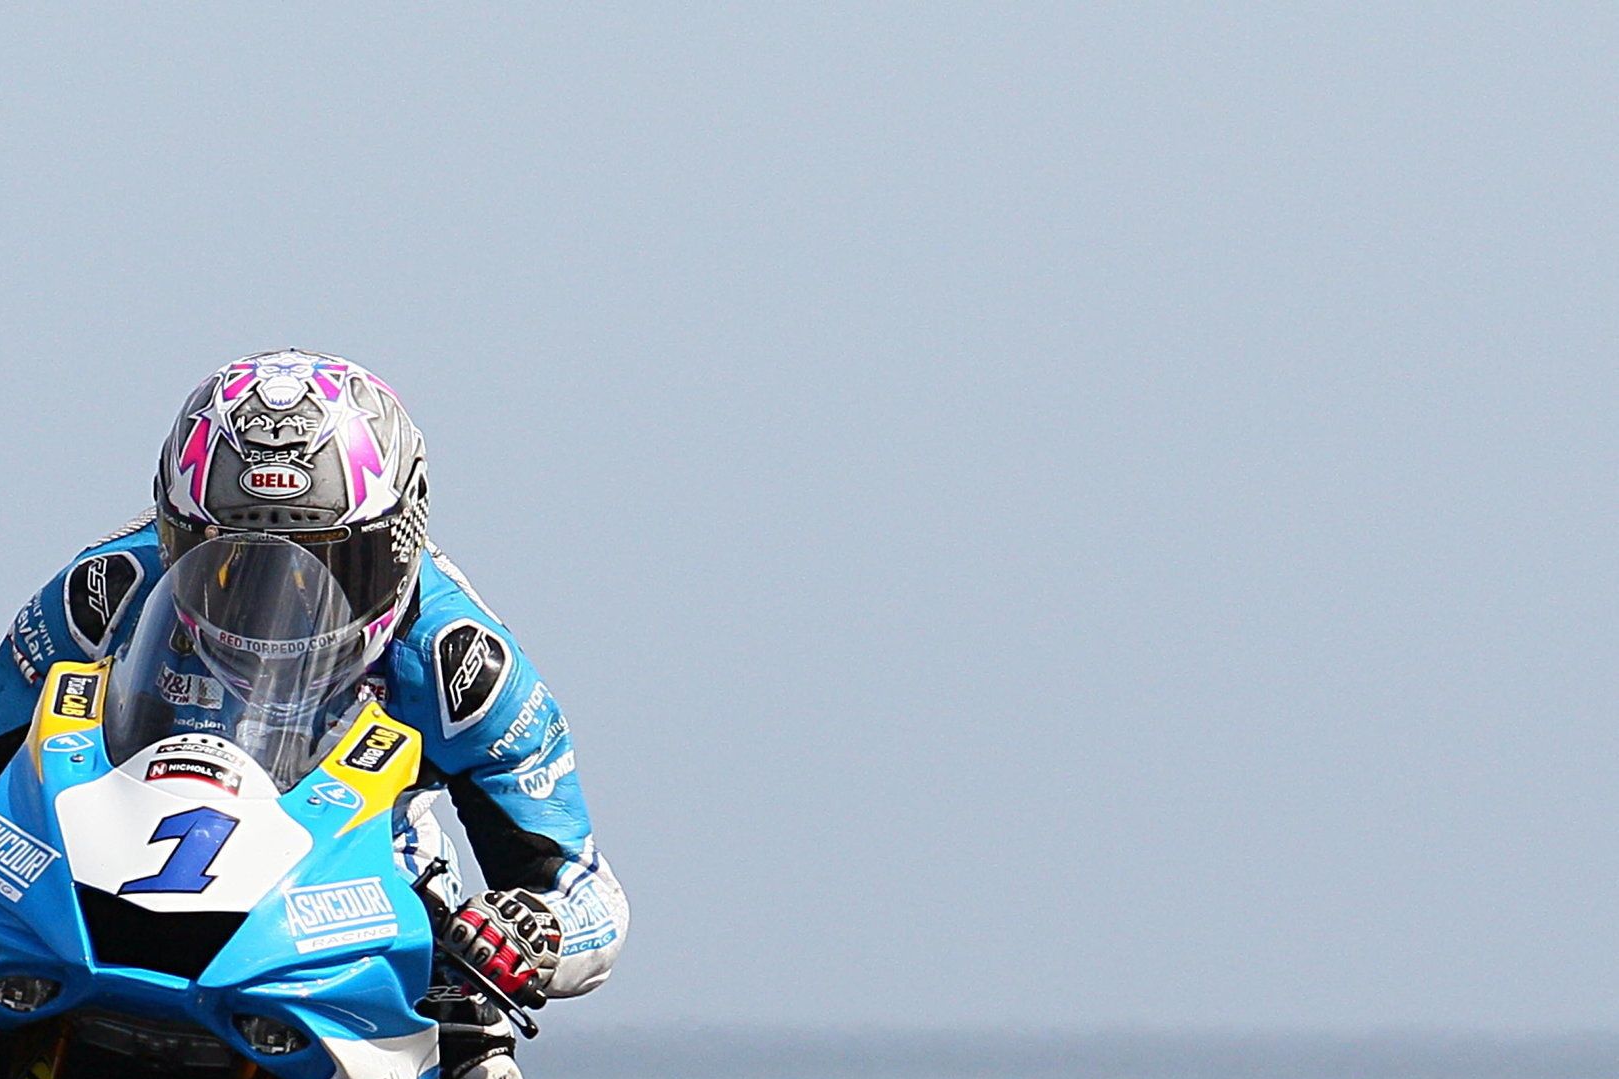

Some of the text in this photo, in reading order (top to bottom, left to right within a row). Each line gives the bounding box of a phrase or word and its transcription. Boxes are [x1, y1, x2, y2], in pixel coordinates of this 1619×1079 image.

[251, 473, 299, 488] BELL
[87, 556, 109, 626] RST
[38, 620, 56, 656] WITH
[219, 632, 243, 648] RED
[449, 629, 492, 712] RST
[61, 694, 88, 717] CAB
[350, 728, 400, 769] fona CAB
[169, 763, 213, 777] NICHOLL
[119, 806, 240, 896] 1
[282, 876, 397, 938] ASHCOURT
[312, 926, 392, 949] RACING
